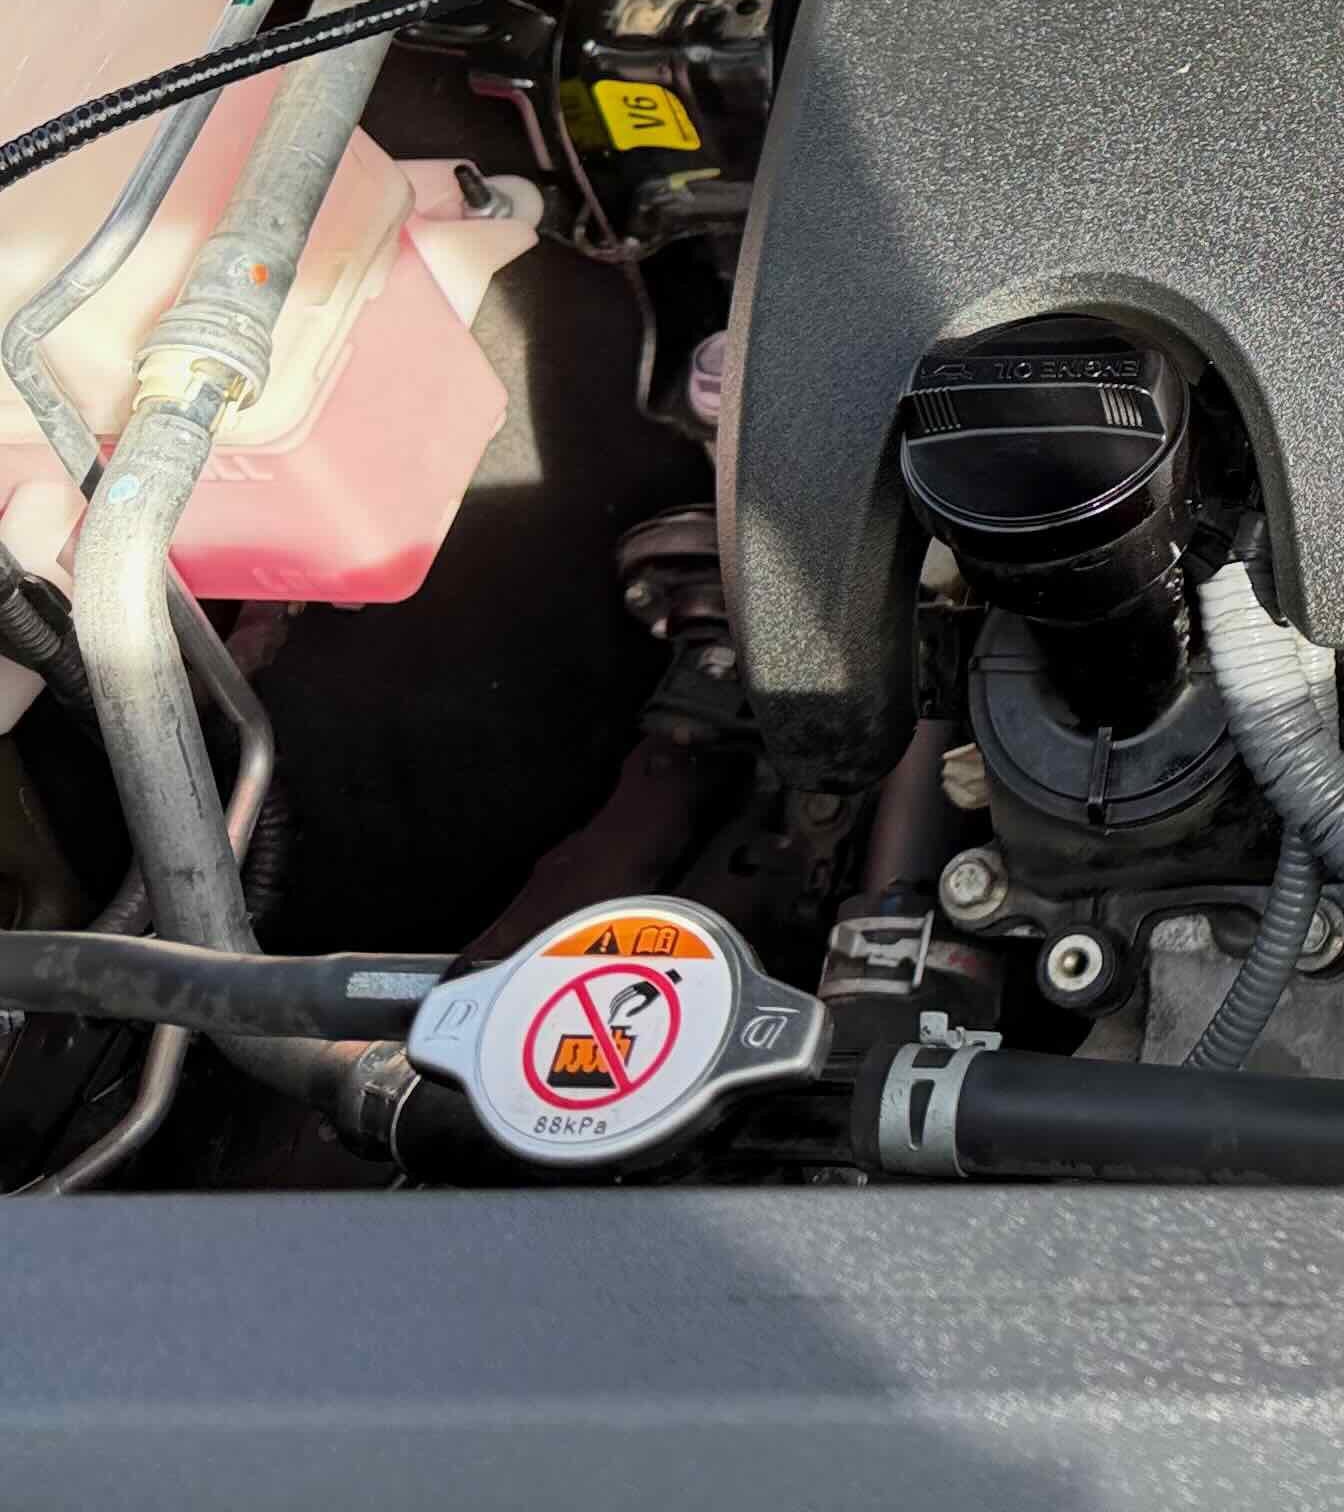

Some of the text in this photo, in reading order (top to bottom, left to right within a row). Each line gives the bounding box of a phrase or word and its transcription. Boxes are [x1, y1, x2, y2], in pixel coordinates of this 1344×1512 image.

[623, 95, 665, 130] V6
[993, 359, 1139, 379] ENGINE OIL
[534, 1117, 608, 1136] 88kPa
